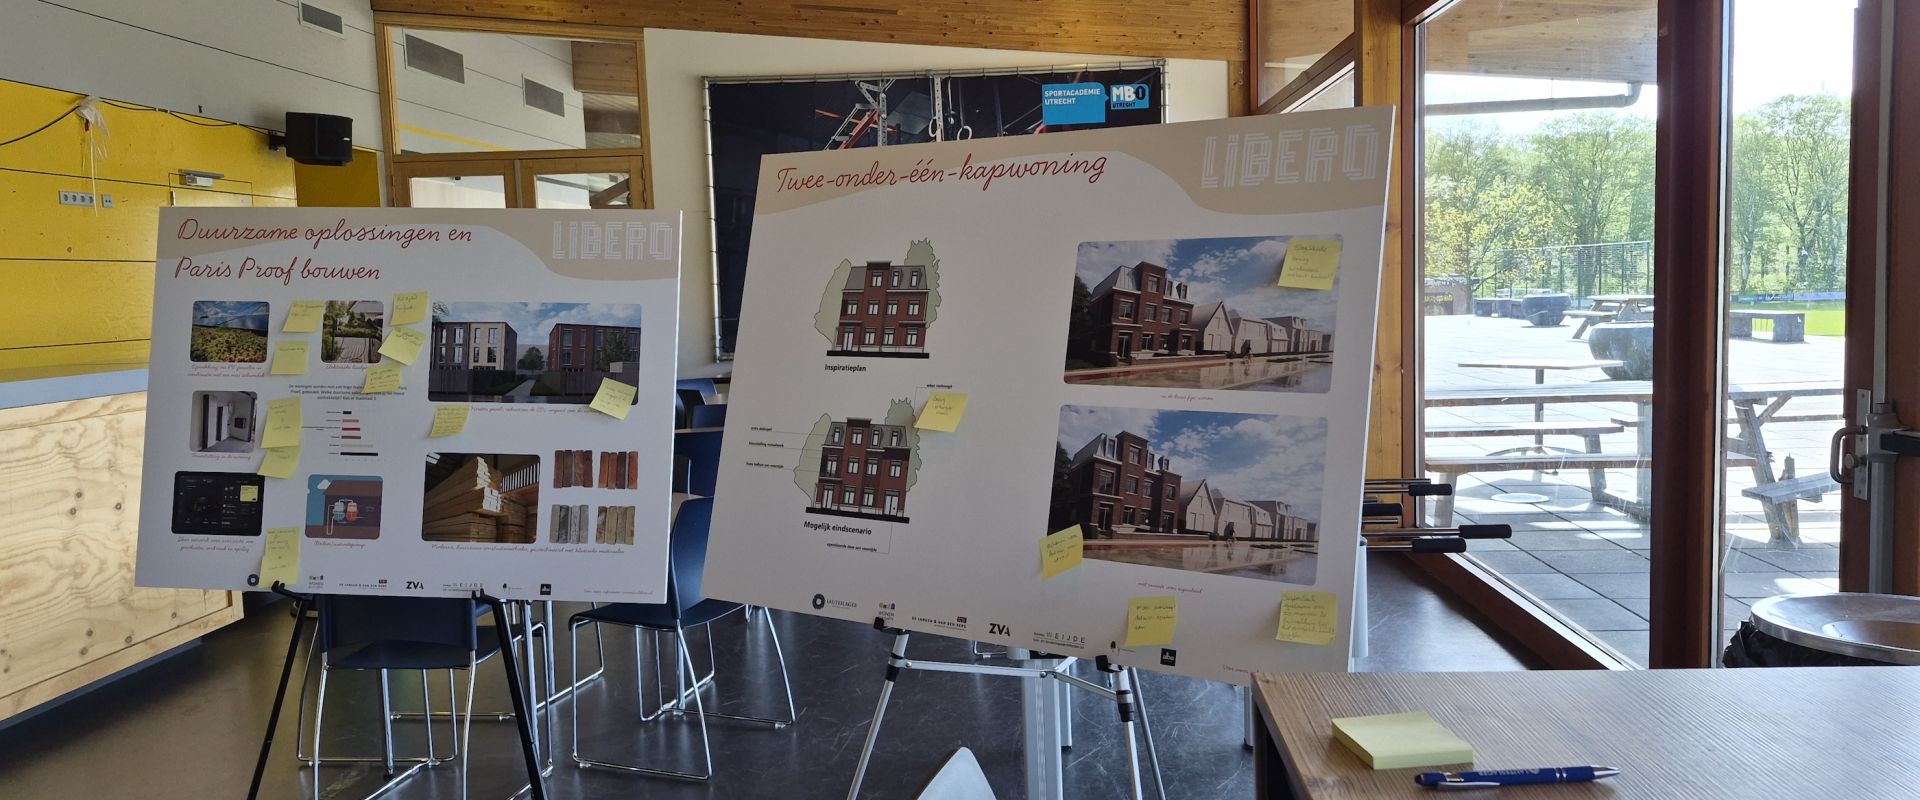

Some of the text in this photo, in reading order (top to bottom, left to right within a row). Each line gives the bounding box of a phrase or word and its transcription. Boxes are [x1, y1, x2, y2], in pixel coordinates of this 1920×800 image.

[1045, 88, 1101, 98] SPORTACADEMIE
[1112, 85, 1146, 102] MBO
[777, 152, 1108, 193] Twee-onder-één-kapwoning
[177, 217, 474, 249] Duurzame oplossingen en
[174, 256, 381, 286] Paris Proof bouwen
[824, 363, 868, 375] Inspiratieplan
[803, 520, 872, 535] Mogelijk eindscenario
[406, 581, 424, 590] ZVA
[988, 623, 1011, 637] ZVA
